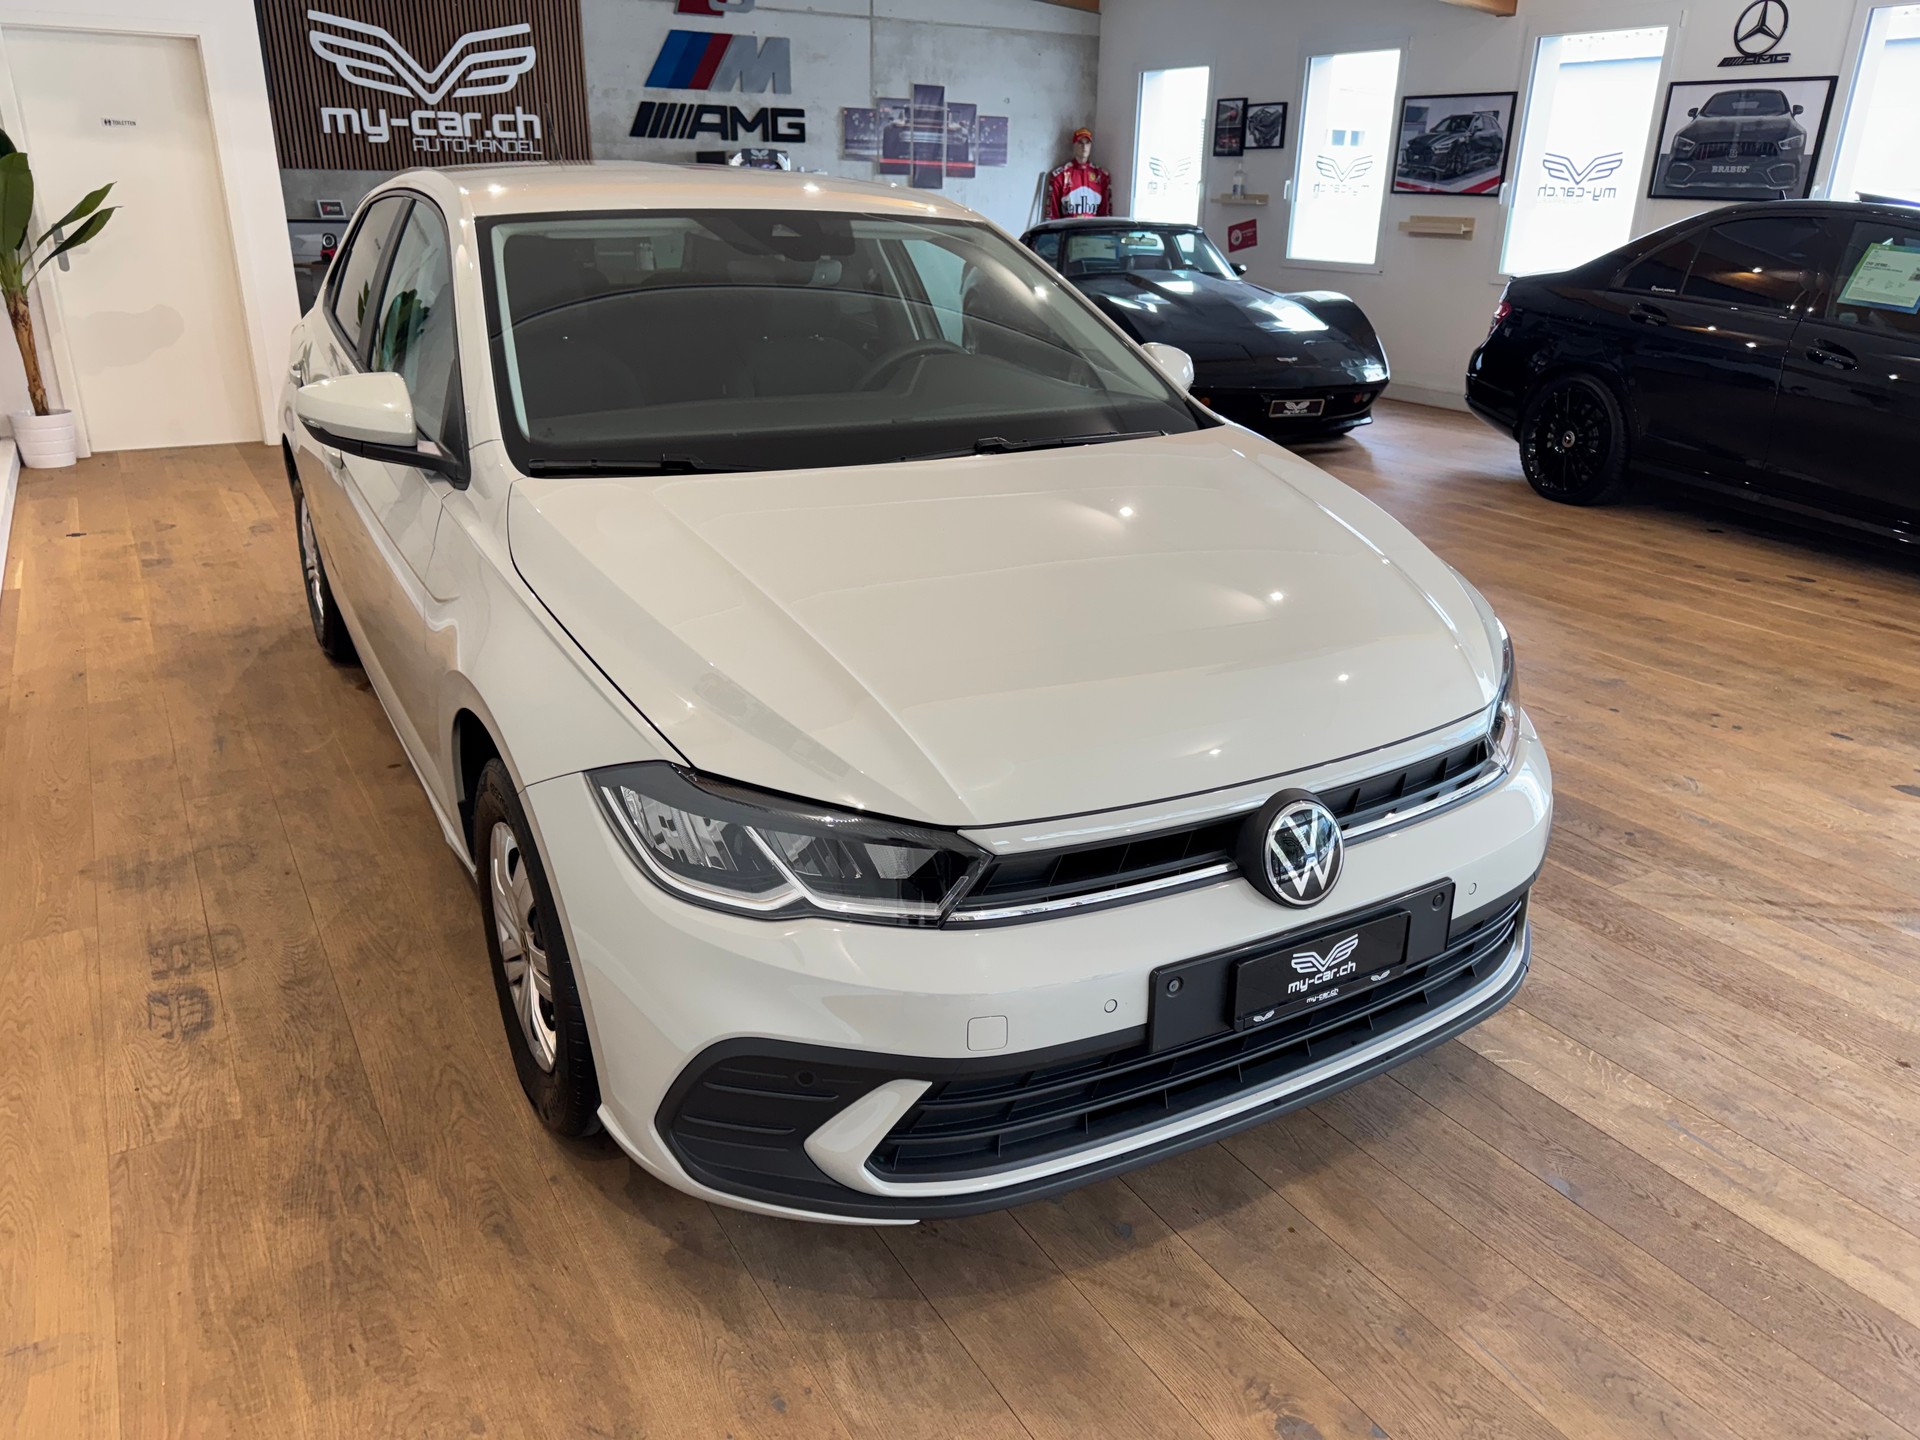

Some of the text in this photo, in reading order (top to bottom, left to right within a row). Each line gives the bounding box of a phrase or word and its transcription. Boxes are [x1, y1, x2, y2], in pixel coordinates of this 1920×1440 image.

[1740, 53, 1791, 66] AMG
[320, 106, 542, 143] my-car.ch
[687, 104, 806, 143] AMG
[412, 137, 543, 155] AUTOHANDEL
[1711, 165, 1749, 174] BRABUS
[1287, 961, 1356, 994] my-car.ch
[1306, 988, 1339, 1003] my-car.ch
